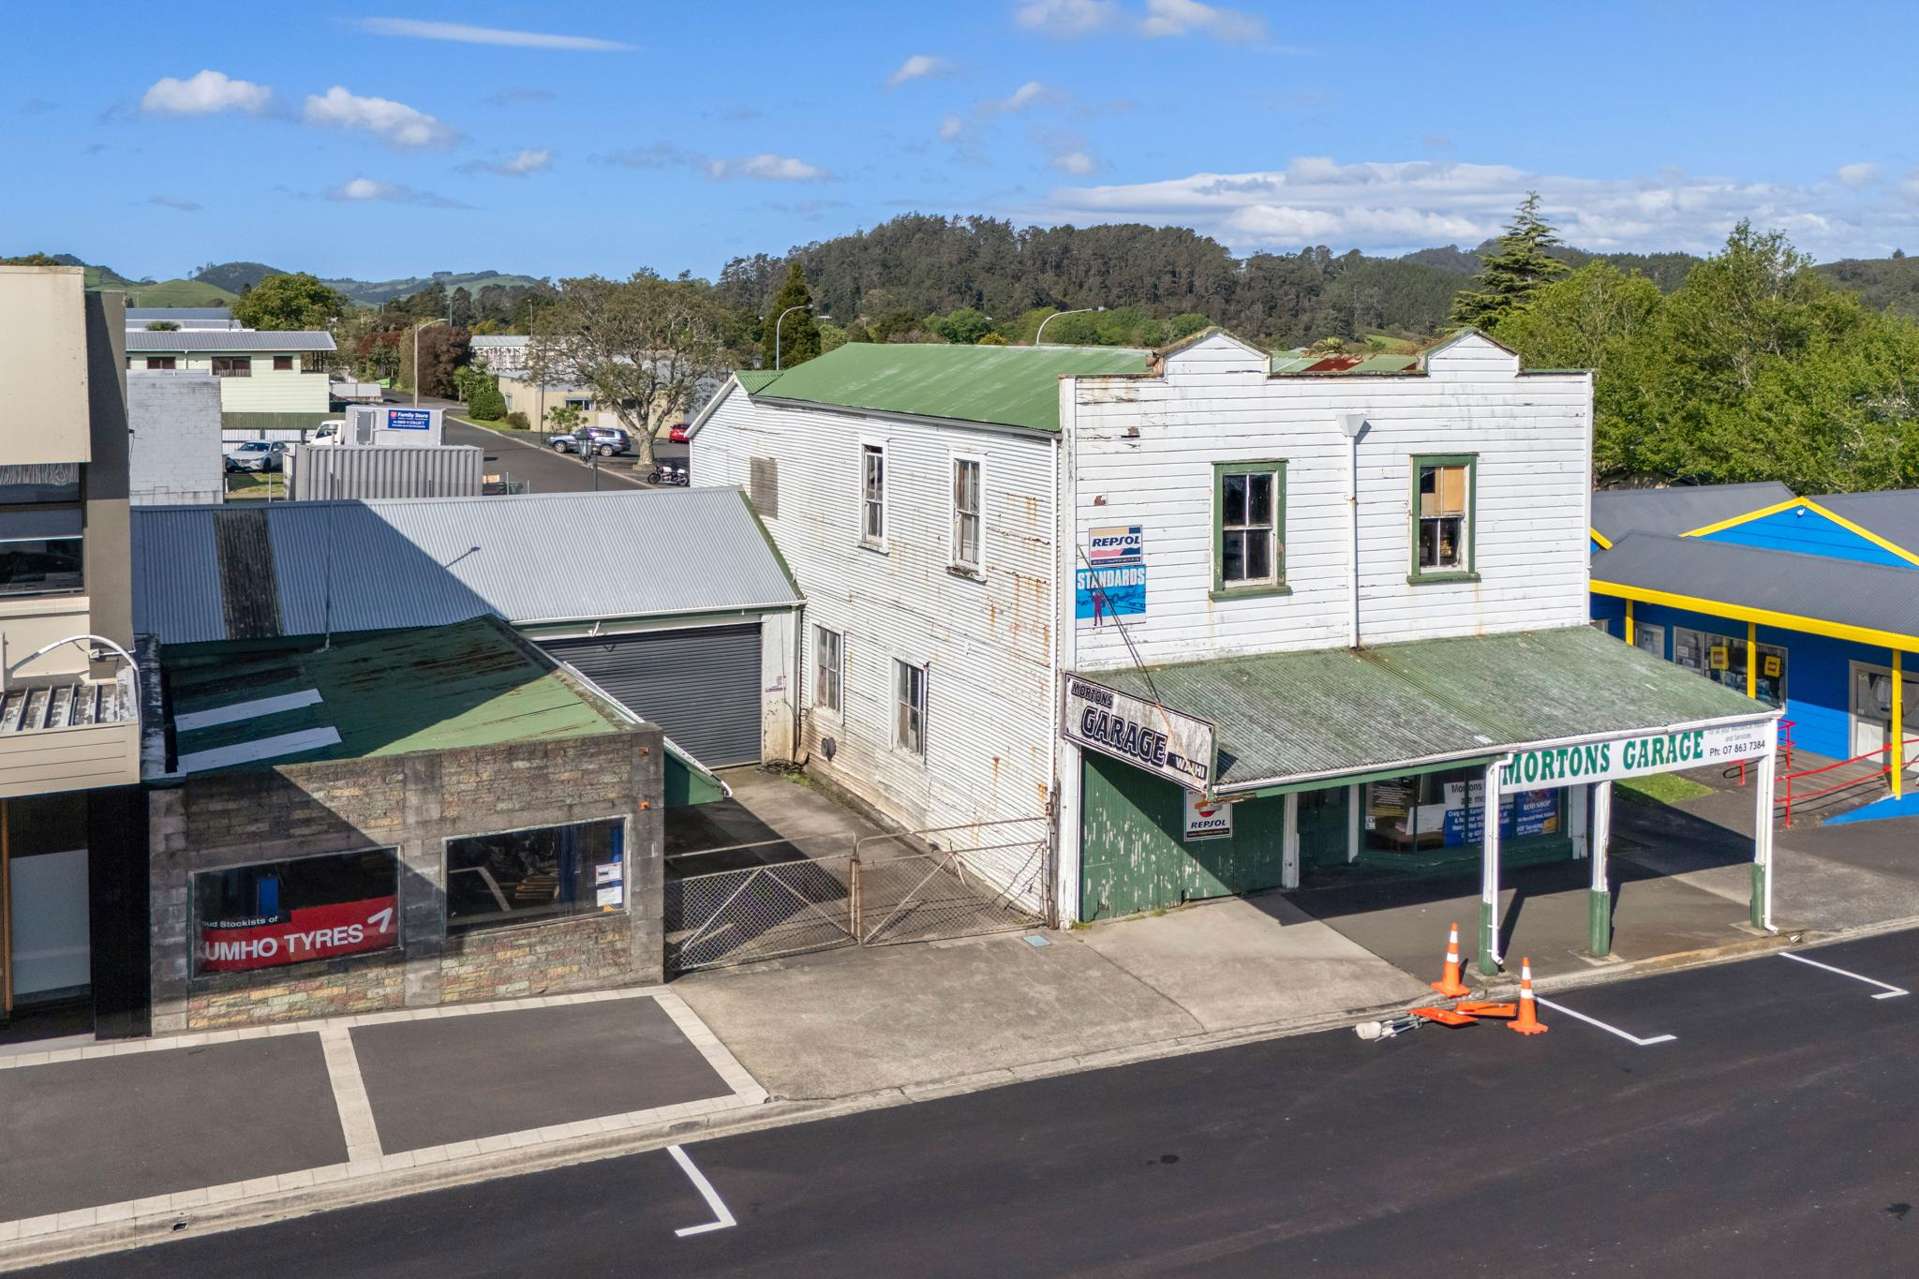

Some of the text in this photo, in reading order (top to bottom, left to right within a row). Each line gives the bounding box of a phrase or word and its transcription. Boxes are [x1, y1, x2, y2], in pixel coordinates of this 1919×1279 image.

[1092, 535, 1140, 547] REPSOL
[1077, 568, 1145, 590] STANDARDS
[1071, 680, 1113, 709] MORTONS
[1081, 705, 1169, 767] GARAGE
[1502, 730, 1705, 785] MORTONS GARAGE
[1709, 740, 1766, 757] Ph: 07 863 7384
[1451, 783, 1483, 793] Moons
[1191, 819, 1226, 829] REPSOL
[219, 917, 266, 928] Stockists
[268, 915, 278, 923] of
[284, 924, 364, 953] TYRES
